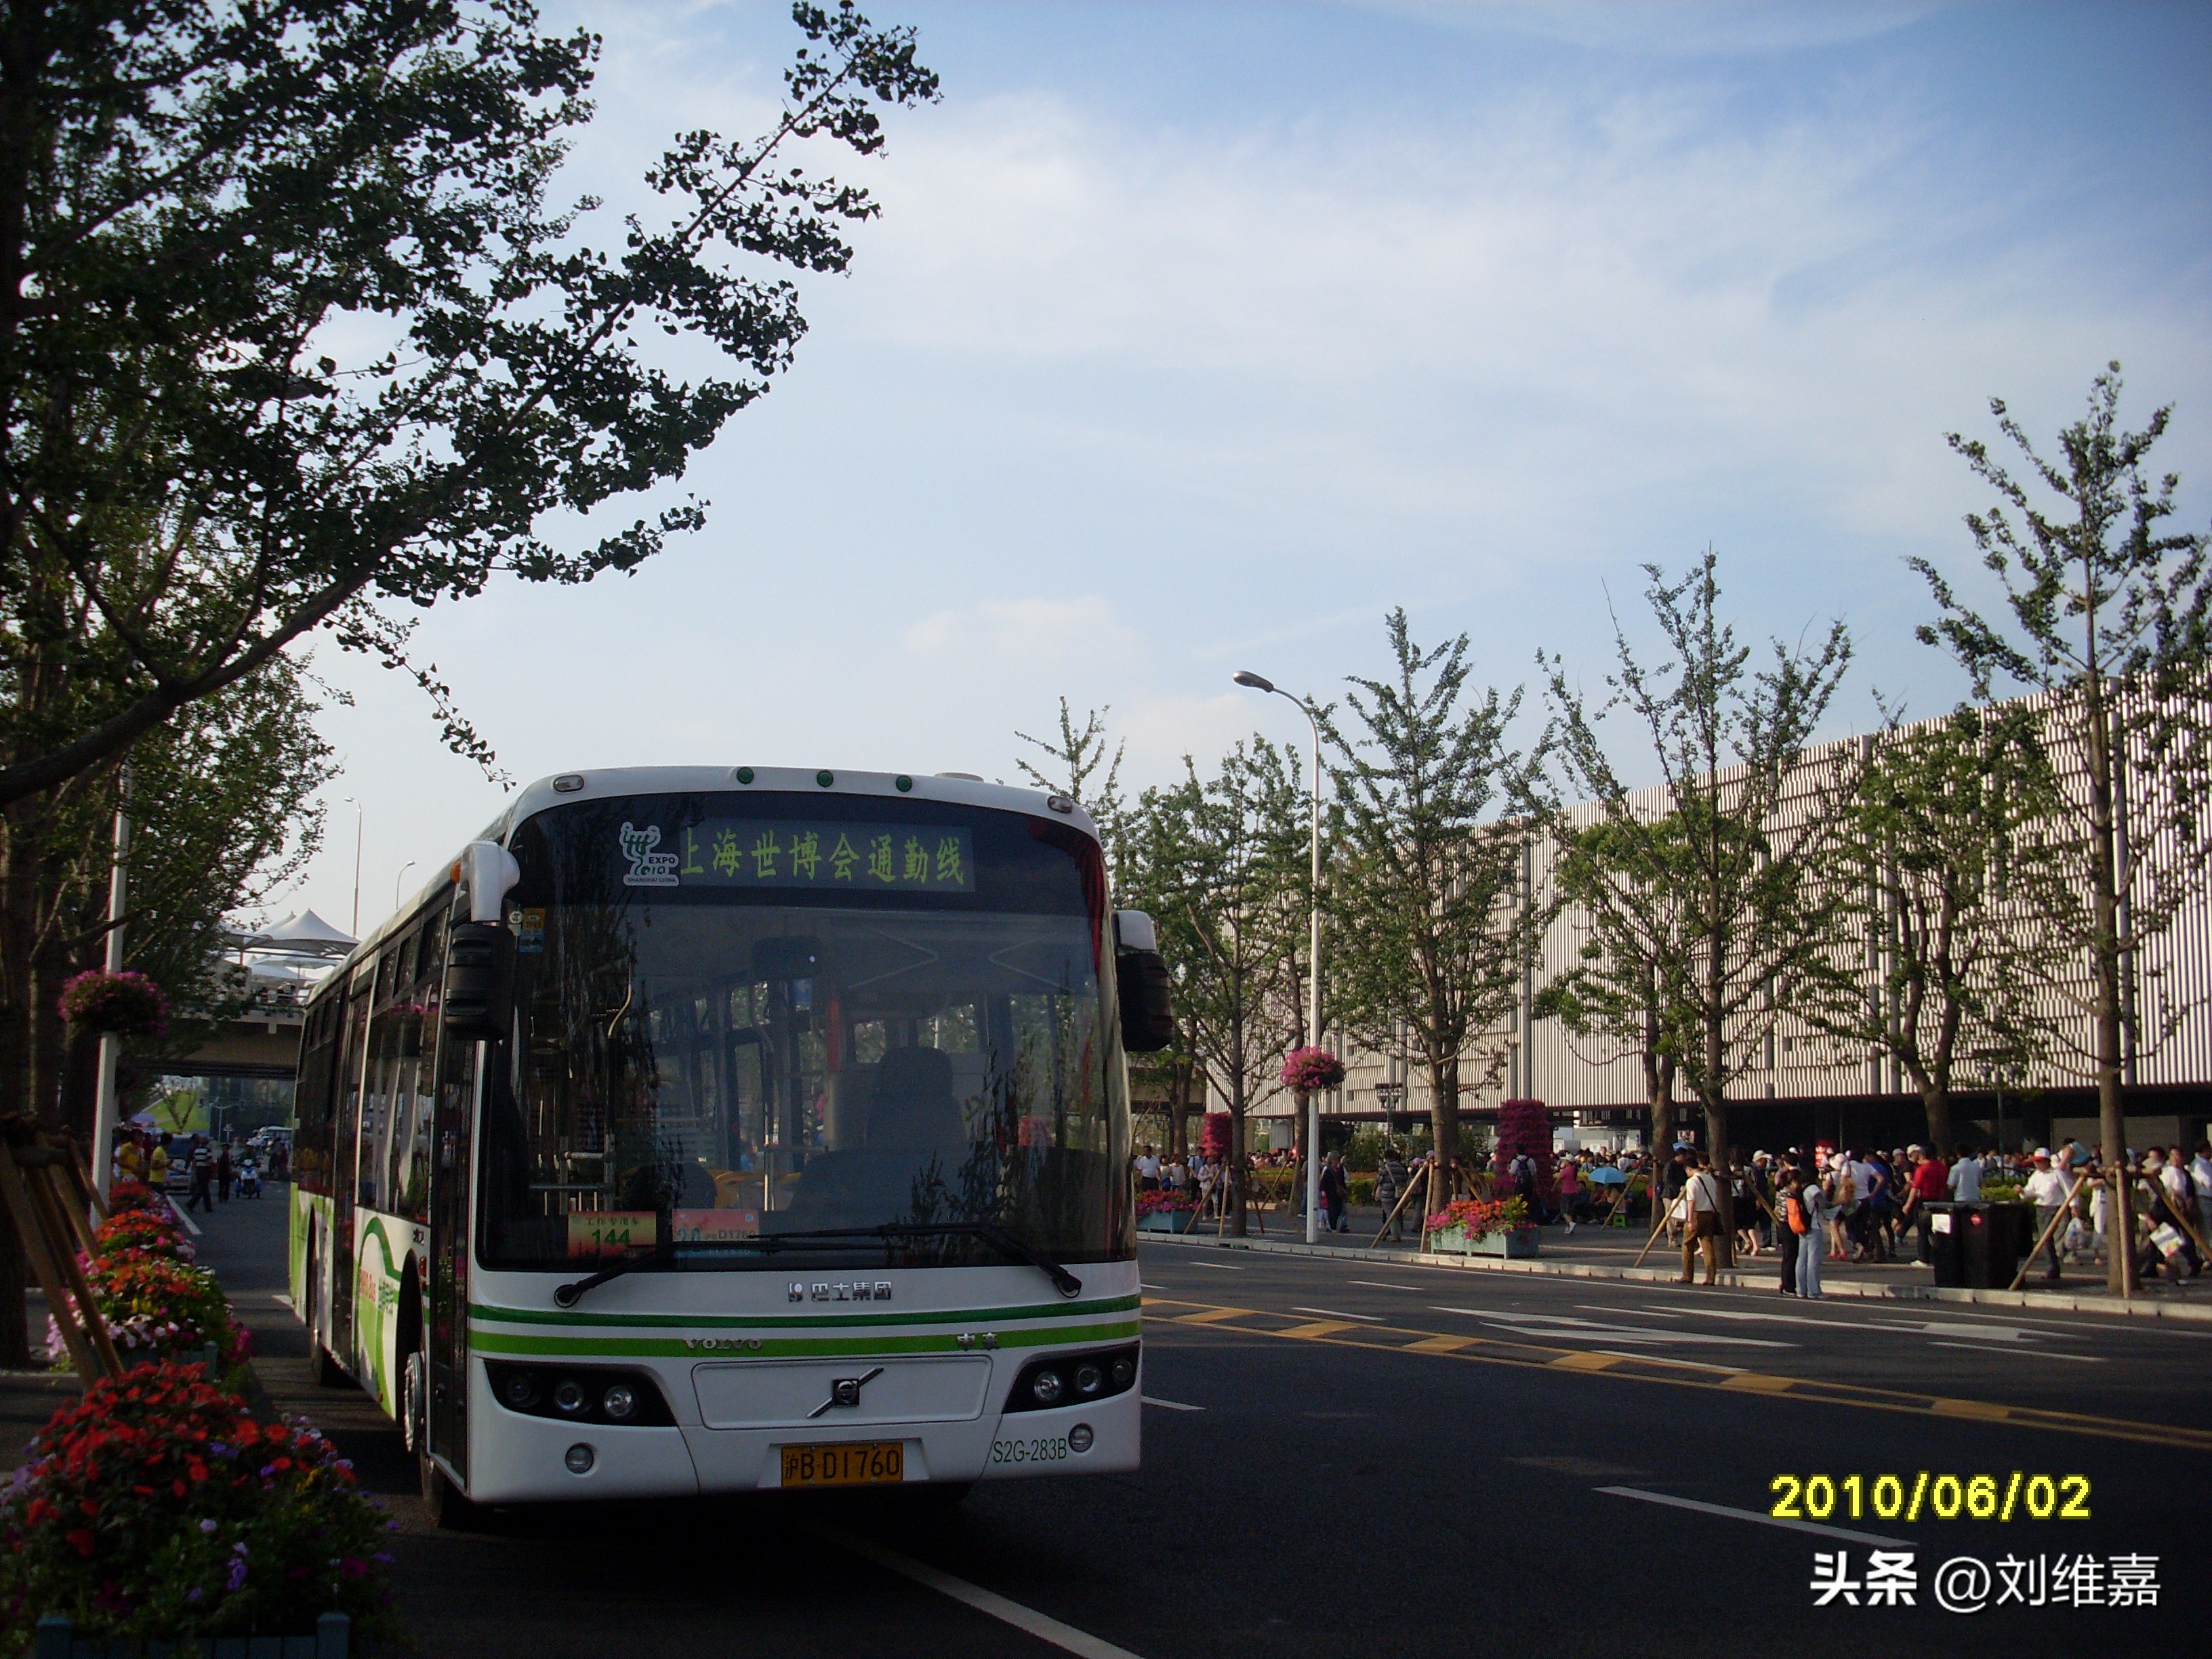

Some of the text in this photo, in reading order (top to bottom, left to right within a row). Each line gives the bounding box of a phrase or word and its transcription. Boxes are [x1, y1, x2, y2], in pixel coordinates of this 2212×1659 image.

[680, 827, 964, 884] 上海世博会通勤线
[592, 1229, 631, 1246] 144
[811, 1281, 892, 1302] 巴士集团
[684, 1338, 762, 1350] VOLVO
[993, 1437, 1067, 1463] S2G-283B
